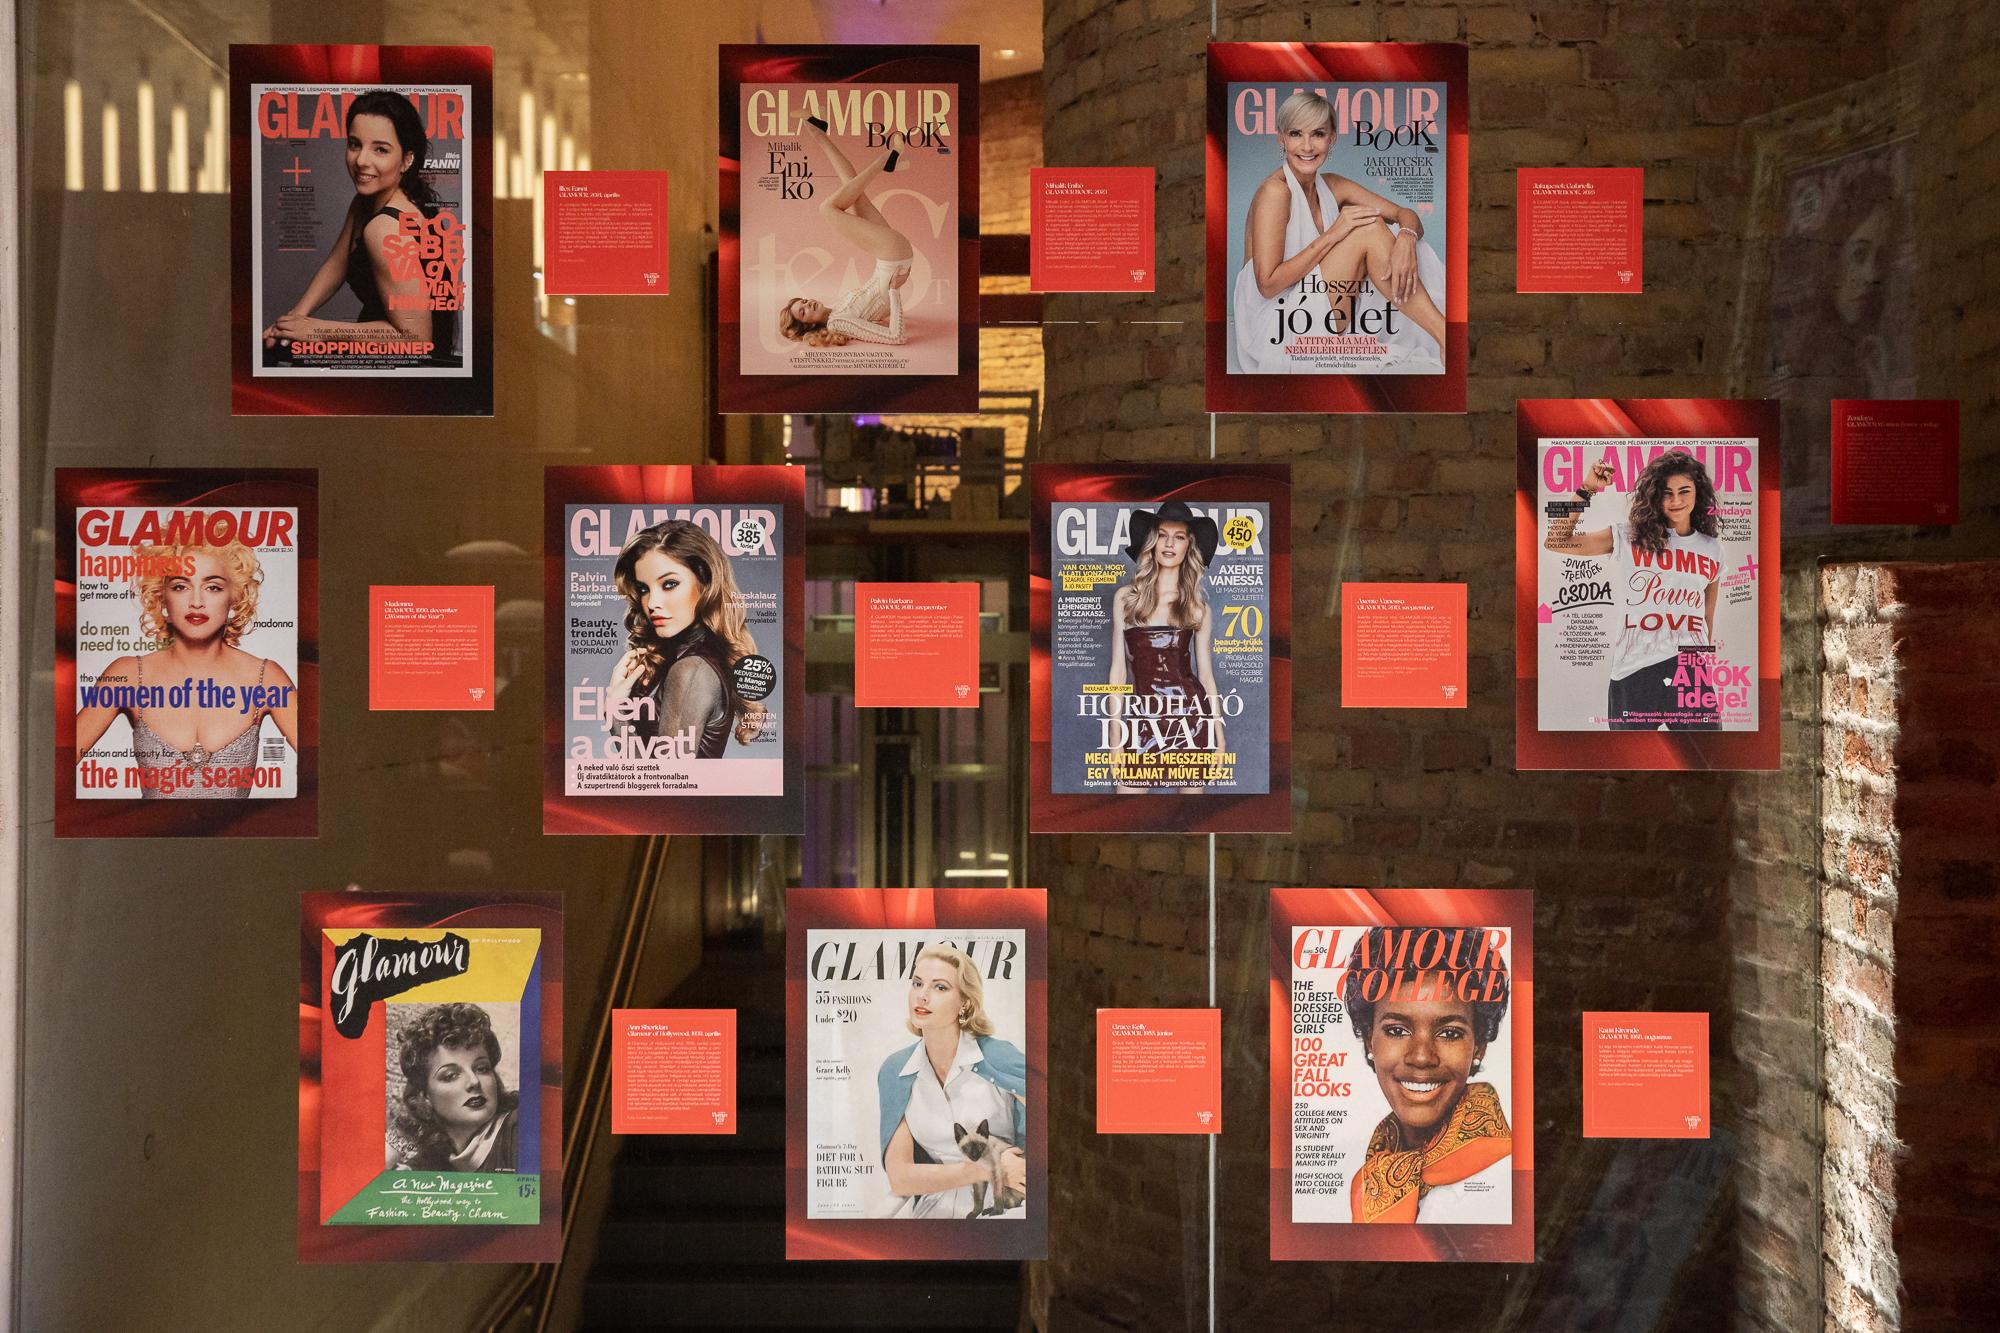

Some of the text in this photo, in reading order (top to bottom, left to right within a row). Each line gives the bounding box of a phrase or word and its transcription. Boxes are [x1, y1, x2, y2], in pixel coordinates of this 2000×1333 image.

[747, 89, 951, 136] GLAMOUR
[768, 141, 802, 151] Mihalik
[424, 159, 460, 168] FANNI
[1364, 156, 1433, 167] JAKUPCSEK
[1366, 167, 1433, 177] GABRIELLA
[1270, 295, 1399, 344] jó élet
[1305, 337, 1334, 346] TITOK
[1353, 335, 1376, 344] MÁR
[1285, 345, 1387, 354] NEM ELÉRHETETLEN
[1707, 506, 1752, 517] Zendaya
[78, 509, 294, 547] GLAMOUR
[741, 521, 758, 531] CSAK
[1232, 520, 1248, 528] CSAK
[736, 529, 761, 544] 385
[1227, 527, 1252, 543] 450
[80, 548, 196, 582] happiness
[1631, 545, 1721, 580] WOMEN
[1219, 565, 1264, 575] AXENTE
[570, 572, 606, 582] Palvin
[1209, 575, 1263, 586] VANESSA
[80, 581, 109, 590] how to
[570, 583, 618, 593] Barbara
[1627, 569, 1704, 609] Power
[80, 592, 97, 601] get
[119, 590, 129, 599] of
[130, 590, 135, 599] it
[253, 620, 294, 628] madonna
[571, 618, 617, 629] Beauty-
[1221, 605, 1263, 638] 70
[1625, 612, 1703, 632] LOVE
[80, 621, 129, 635] do men
[571, 628, 617, 638] trendek
[80, 638, 130, 651] need to
[743, 659, 772, 674] 25%
[80, 674, 128, 682] the winners
[1672, 660, 1752, 687] A NŐK
[80, 678, 294, 714] women of the year
[1678, 687, 1748, 712] ideje!
[572, 677, 655, 732] Éljen
[1077, 688, 1244, 717] HORDHATÓ
[744, 712, 777, 720] KRISTEN
[742, 721, 777, 729] STEWART
[1097, 717, 1227, 750] DIVAT
[571, 726, 696, 759] a divat!
[80, 748, 110, 757] fashion
[112, 748, 128, 757] and
[129, 748, 160, 759] beauty
[1085, 751, 1236, 765] MEGLÁTNI ÉS MEGSZERETNI
[80, 759, 281, 794] the magic season
[1088, 765, 1233, 779] EGY PILLANAT MŰVE LESZ!
[1293, 928, 1508, 970] GLAMOUR
[1294, 981, 1314, 991] THE
[1336, 970, 1508, 1002] COLLEGE
[815, 990, 872, 1005] 55 FASHIONS
[1294, 992, 1337, 1002] 10 BEST-
[1294, 1003, 1342, 1013] DRESSED
[815, 1009, 857, 1023] Under $20
[1294, 1014, 1343, 1024] COLLEGE
[1294, 1024, 1325, 1034] GIRLS
[1294, 1038, 1322, 1051] 100
[1294, 1053, 1347, 1067] GREAT
[816, 1066, 851, 1075] Grace Kelly
[1294, 1069, 1330, 1082] FALL
[1294, 1083, 1351, 1097] LOOKS
[817, 1153, 864, 1162] DIET FOR A
[817, 1165, 874, 1175] BATHING SUIT
[439, 1176, 494, 1194] Magazine
[817, 1179, 848, 1188] FIGURE
[1295, 1187, 1338, 1195] MAKE-OVER
